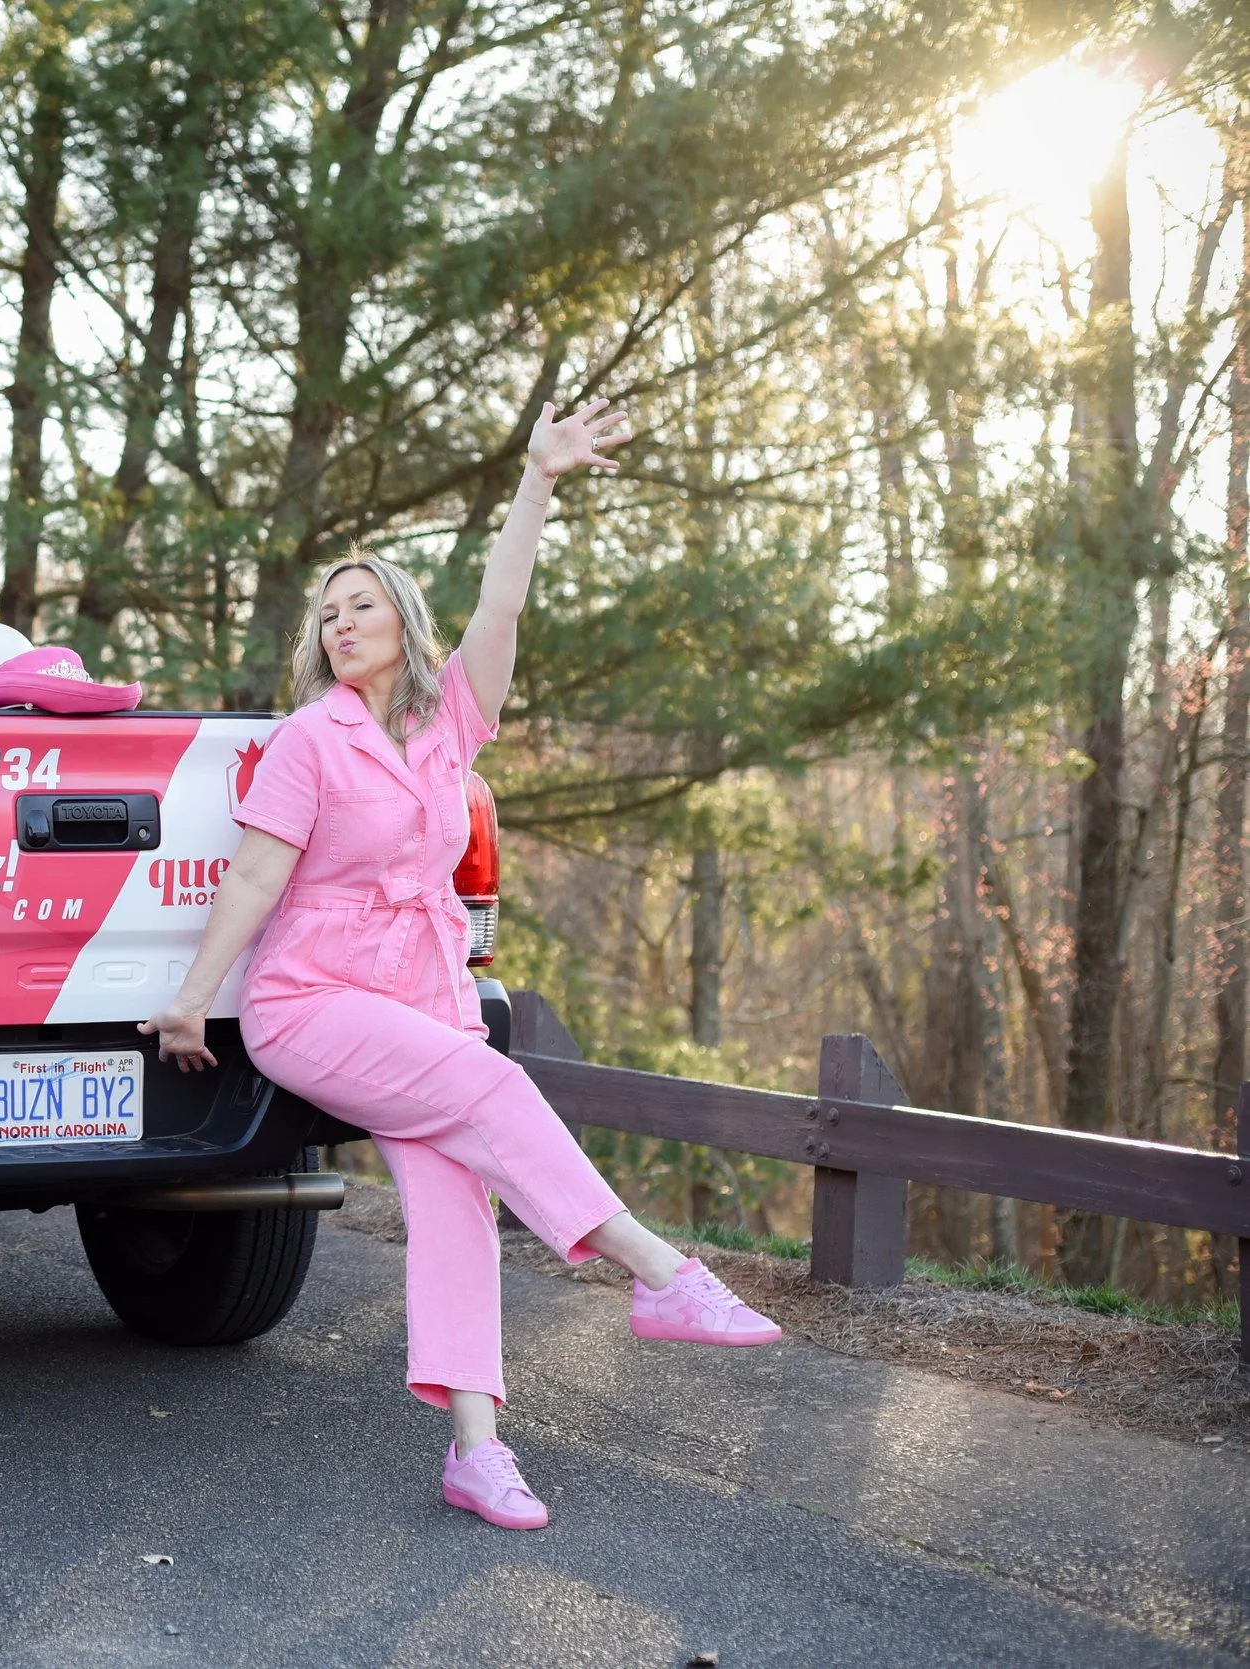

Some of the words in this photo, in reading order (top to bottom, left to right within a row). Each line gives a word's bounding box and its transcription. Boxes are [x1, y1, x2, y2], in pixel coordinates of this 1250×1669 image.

[61, 805, 124, 820] TOYOTA
[19, 1063, 47, 1075] First
[54, 1061, 65, 1074] in
[73, 1060, 107, 1075] Flight
[117, 1065, 127, 1074] 24
[119, 1058, 134, 1067] APR
[82, 1075, 135, 1118] BY2
[55, 1123, 128, 1138] CAROLINA
